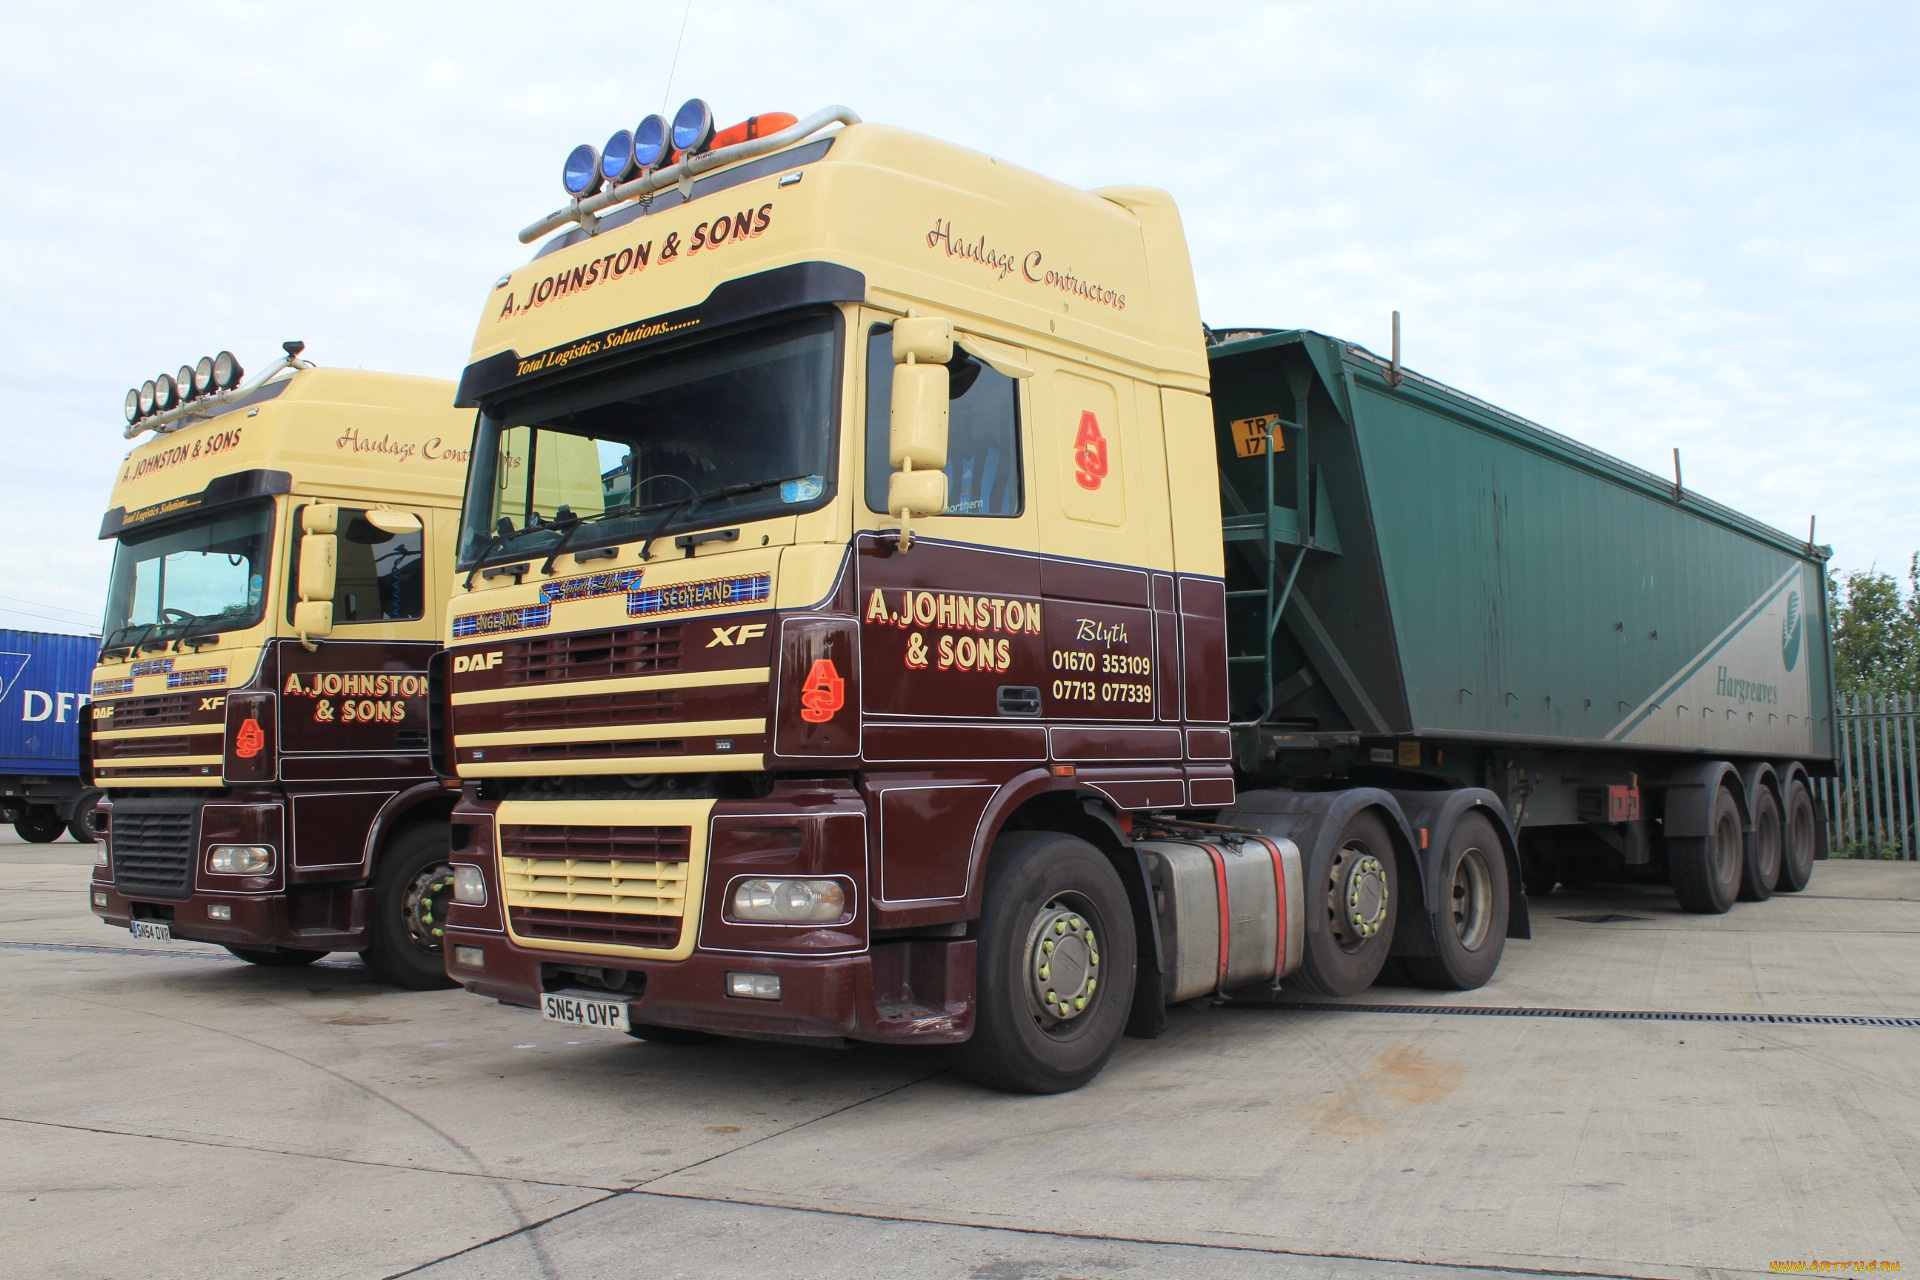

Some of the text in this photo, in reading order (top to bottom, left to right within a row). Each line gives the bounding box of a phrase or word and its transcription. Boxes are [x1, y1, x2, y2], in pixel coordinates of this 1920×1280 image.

[657, 231, 681, 265] &
[687, 203, 773, 256] SONS
[926, 218, 1127, 311] Haulage Contractors
[516, 354, 547, 376] Total
[546, 340, 601, 366] Logistics
[1244, 418, 1268, 436] TR
[203, 428, 242, 458] SONS
[336, 427, 416, 463] Haulage
[1245, 435, 1270, 454] 17
[662, 584, 732, 607] SCOTLAND
[476, 613, 519, 632] ENGLAND
[1076, 618, 1128, 649] Blyth
[705, 623, 767, 648] XF
[454, 651, 503, 674] DAF
[906, 632, 1011, 674] & SONS
[1052, 649, 1151, 676] 01670 353109
[1052, 680, 1152, 704] 07713 077339
[1716, 665, 1779, 705] Hargreaves
[93, 706, 115, 720] DAF
[198, 697, 226, 711] XF
[314, 699, 407, 723] & SONS
[136, 923, 154, 939] SN54
[547, 997, 620, 1027] SN54 OVP
